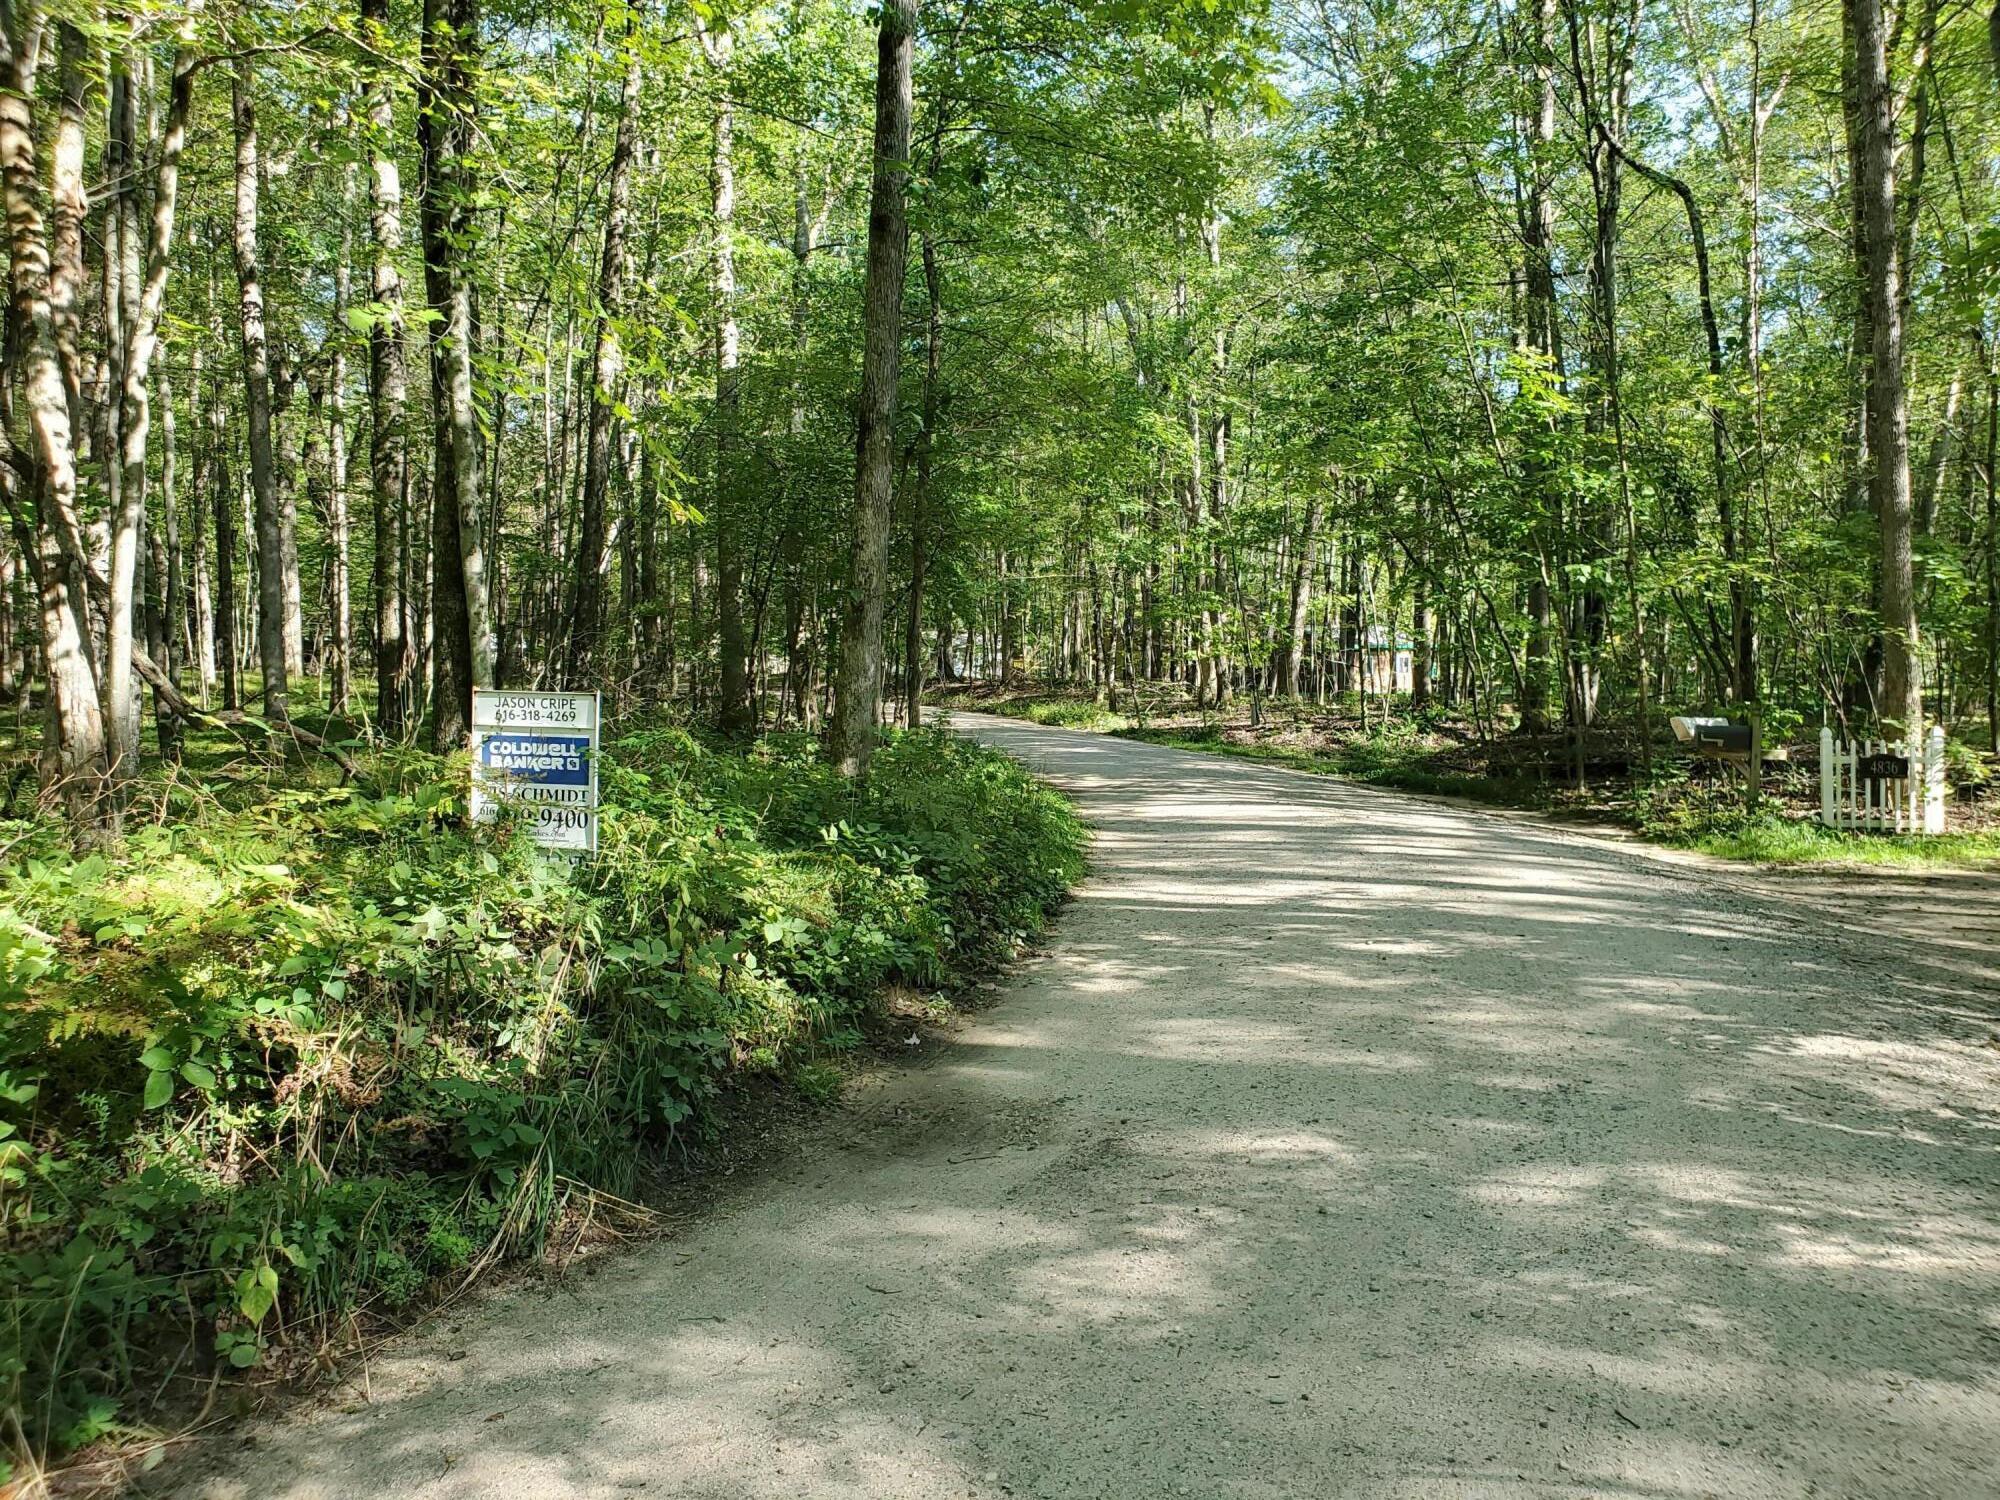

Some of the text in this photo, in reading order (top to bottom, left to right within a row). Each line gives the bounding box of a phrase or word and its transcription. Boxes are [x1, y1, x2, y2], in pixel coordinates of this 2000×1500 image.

[494, 696, 577, 710] JASON CRIPE
[495, 709, 576, 722] 616-318-4269
[489, 741, 580, 757] COLDWELL
[490, 754, 564, 771] BANKER
[1870, 760, 1898, 775] 4836
